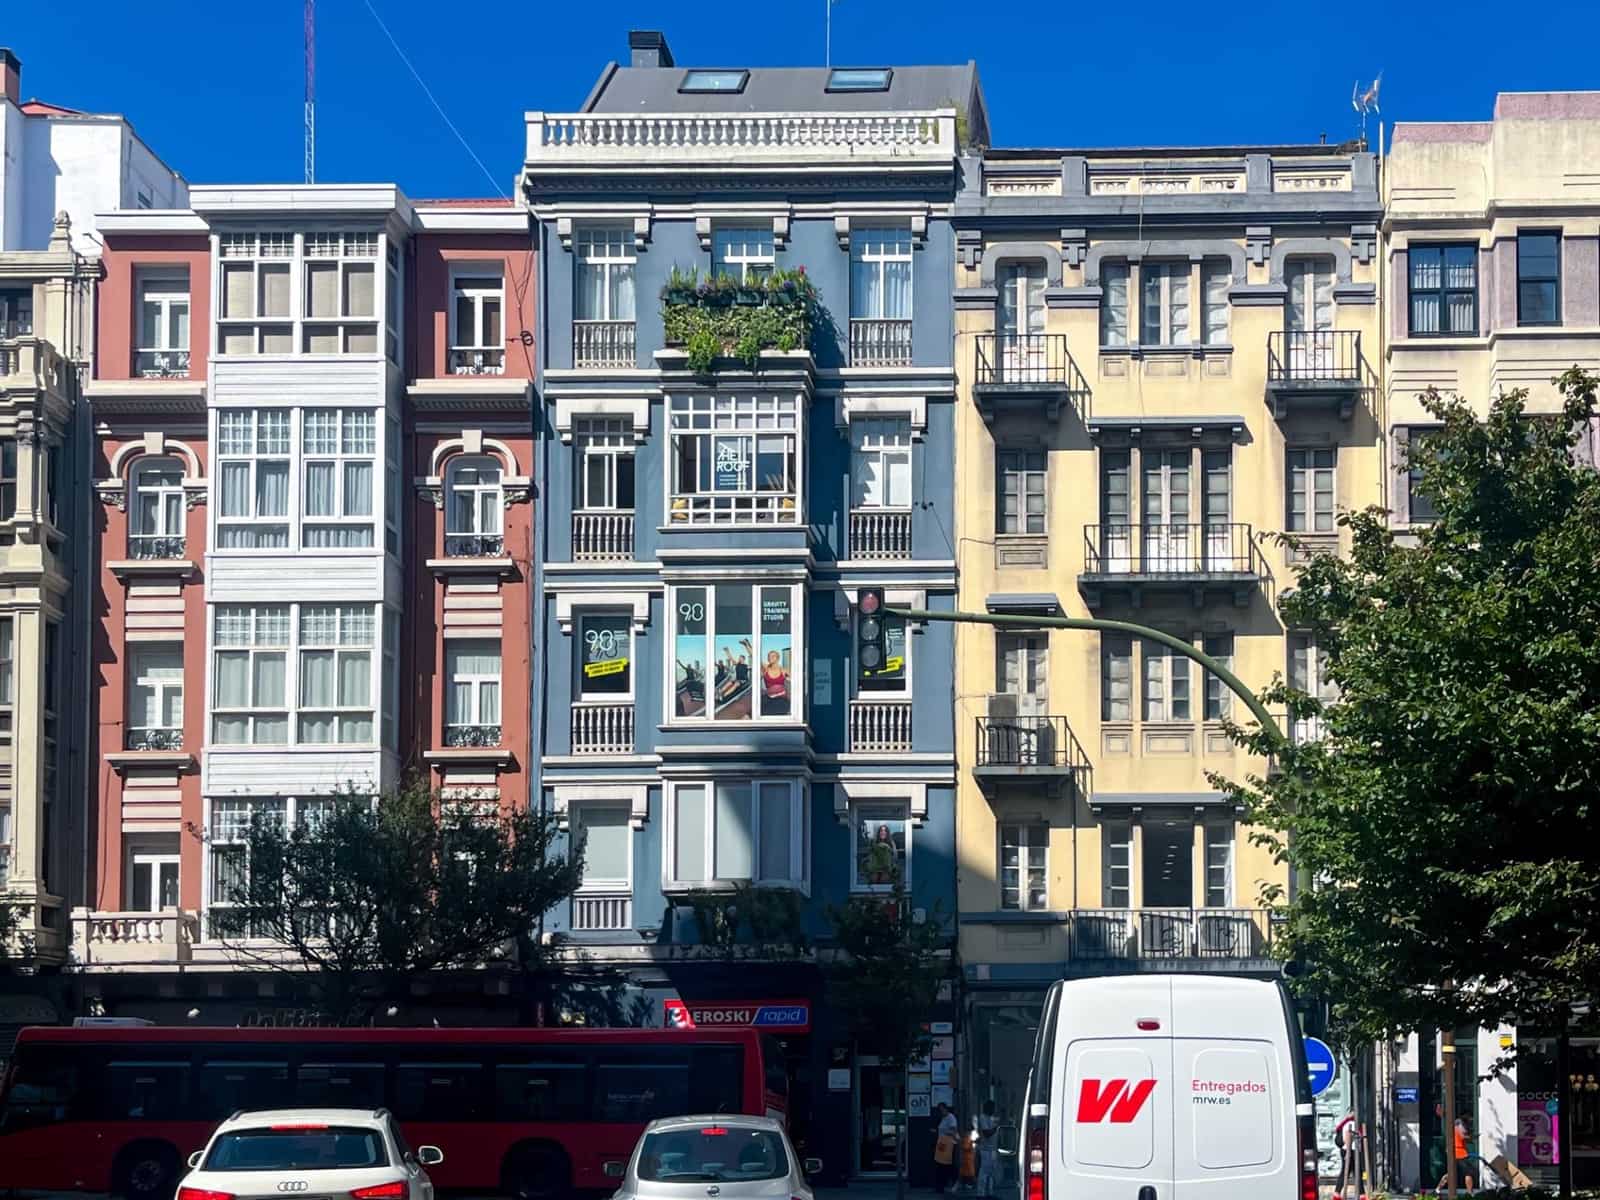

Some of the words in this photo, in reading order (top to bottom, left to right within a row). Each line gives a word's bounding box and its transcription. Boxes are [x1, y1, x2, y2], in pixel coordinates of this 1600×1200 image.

[716, 460, 751, 473] ROOF
[693, 1010, 750, 1023] EROSKI
[763, 1008, 801, 1023] rapid
[1192, 1079, 1266, 1096] Entregados
[1192, 1096, 1231, 1105] mrw.es
